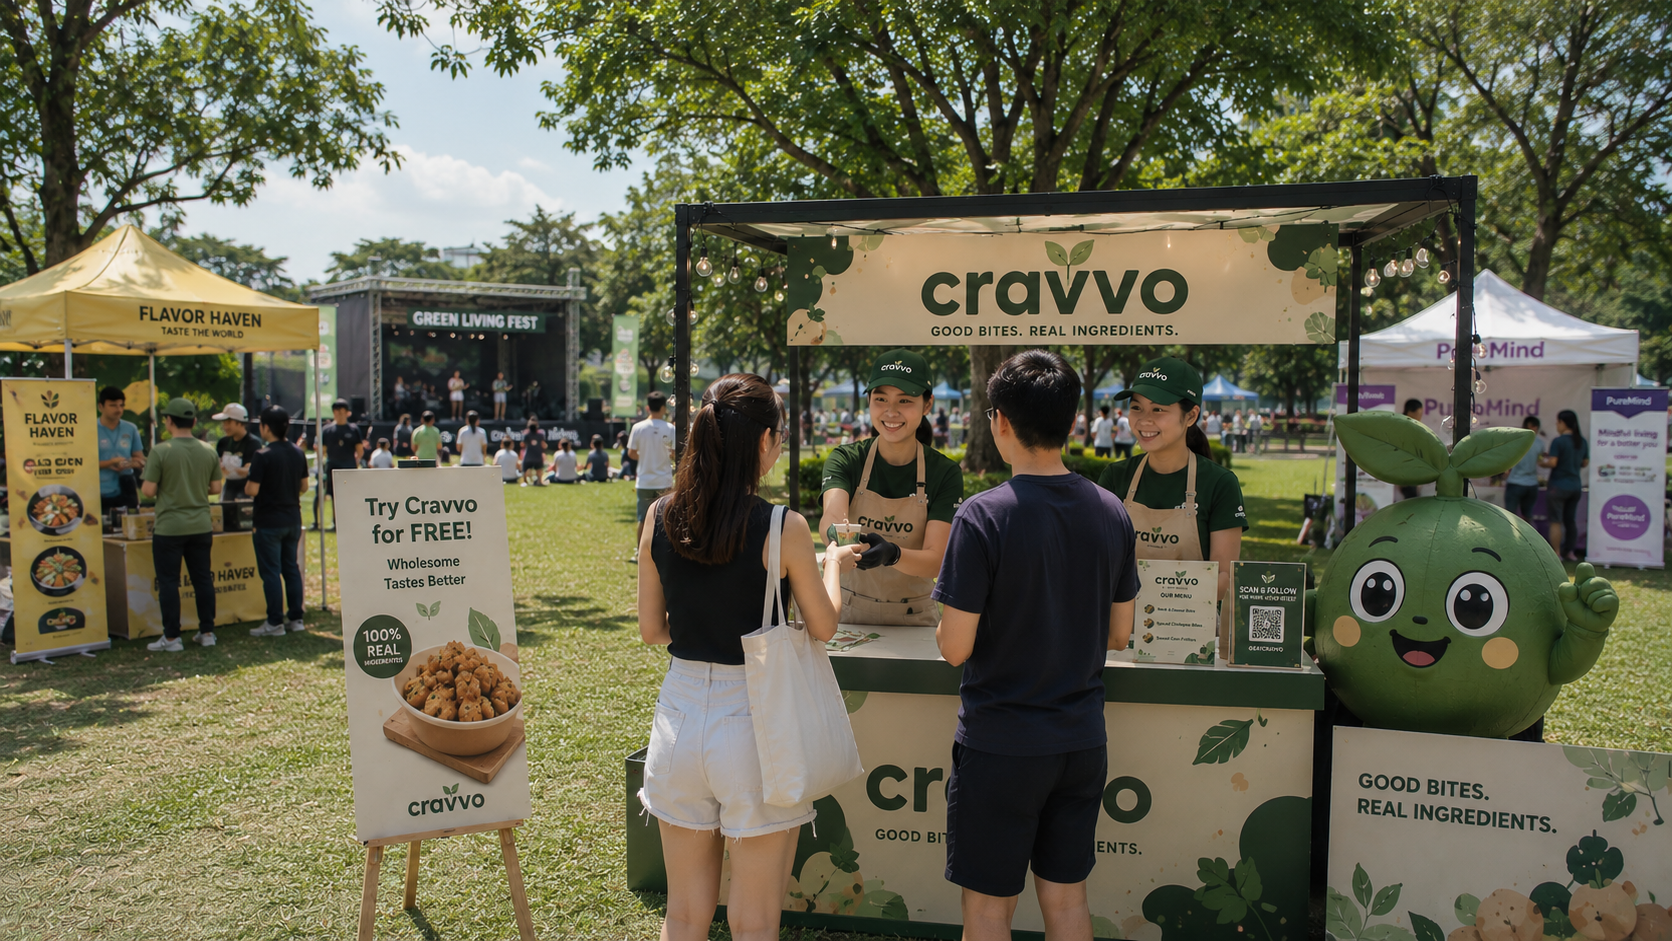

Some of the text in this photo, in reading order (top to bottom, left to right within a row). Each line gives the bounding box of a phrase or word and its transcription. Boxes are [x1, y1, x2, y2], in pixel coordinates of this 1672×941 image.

[921, 269, 1189, 316] cravvo
[139, 306, 262, 328] FLAVOR HAVEN
[412, 311, 539, 330] GREEN LIVING FEST
[161, 326, 244, 339] TASTE THE WORLD
[931, 324, 1179, 337] GOOD BITES. REAL INGREDIENTS.
[1605, 396, 1652, 406] PureMind
[24, 413, 78, 425] FLAVOR
[29, 427, 74, 438] HAVEN
[364, 496, 478, 520] Try Cravvo
[372, 521, 473, 544] for FREE!
[1134, 529, 1180, 544] ravvo
[387, 557, 460, 571] Wholesome
[384, 574, 466, 590] Tastes Better
[1155, 576, 1199, 586] cravvo
[1239, 585, 1259, 594] SCAN
[362, 627, 402, 643] 100%
[367, 643, 401, 658] REAL
[1358, 772, 1490, 801] GOOD BITES.
[407, 793, 485, 817] cravvo
[1357, 798, 1558, 834] REAL INGREDIENTS.
[875, 828, 921, 842] GOOD
